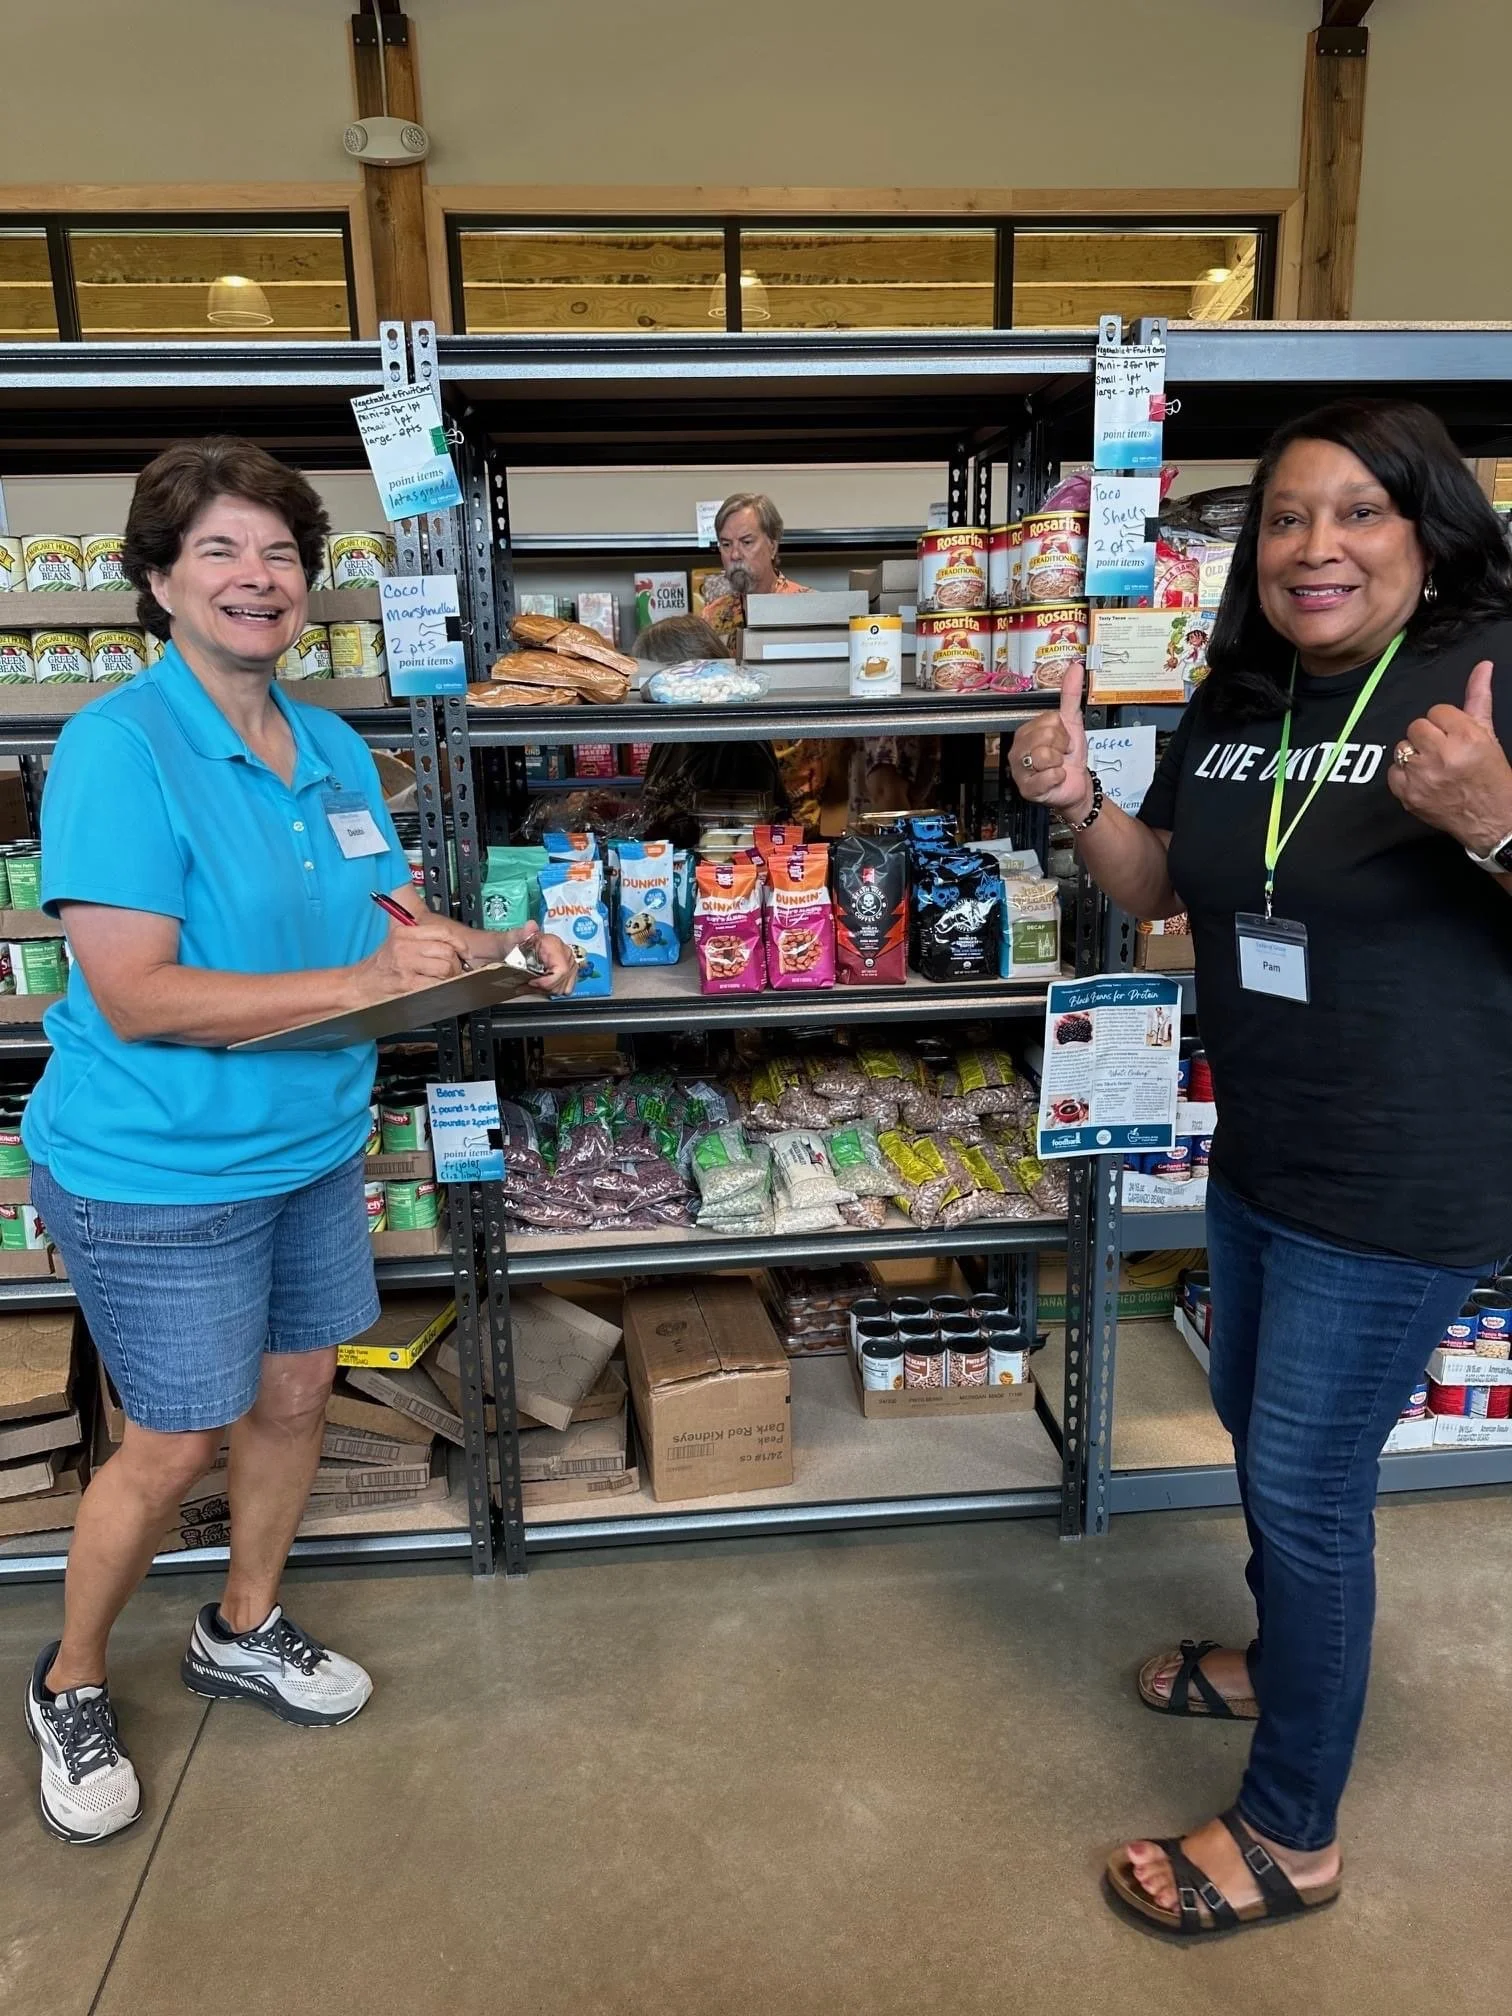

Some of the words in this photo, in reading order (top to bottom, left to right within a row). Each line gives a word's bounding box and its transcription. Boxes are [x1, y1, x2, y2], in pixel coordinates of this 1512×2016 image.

[1103, 429, 1125, 441] point
[1127, 429, 1152, 440] items
[389, 475, 415, 491] point
[416, 468, 444, 482] items
[1093, 483, 1121, 501] Taco
[1102, 506, 1146, 526] Shells
[1029, 517, 1082, 538] Rosarita
[936, 533, 984, 552] Rosarita
[1094, 539, 1105, 552] 2
[345, 560, 374, 569] GREEN
[1031, 554, 1079, 565] TRADITIONAL
[1096, 558, 1119, 568] point
[1120, 557, 1145, 567] items
[38, 563, 70, 572] GREEN
[347, 569, 375, 577] BEANS
[940, 568, 982, 577] TRADITIONAL
[42, 572, 72, 581] BEANS
[657, 588, 684, 600] CORN
[657, 599, 685, 609] FLAKES
[1036, 608, 1088, 629] Rosarita
[933, 615, 980, 635] Rosarita
[391, 637, 402, 654] 2
[410, 639, 436, 656] pts
[1040, 644, 1083, 655] TRADITIONAL
[47, 655, 78, 664] GREEN
[102, 654, 132, 663] GREEN
[935, 649, 978, 659] TRADITIONAL
[0, 656, 26, 665] REEN
[399, 657, 425, 669] point
[427, 657, 455, 667] items
[51, 664, 80, 672] BEANS
[104, 663, 133, 671] BEANS
[1194, 743, 1266, 782] LIVE
[1021, 903, 1053, 913] ROAST
[1263, 961, 1281, 973] Pam
[1128, 988, 1159, 1001] Protein
[436, 1088, 466, 1098] Beans
[439, 1104, 464, 1115] pound
[444, 1151, 467, 1159] point
[1150, 1194, 1166, 1205] BEANS
[727, 1426, 752, 1439] Red
[755, 1422, 785, 1436] Dark
[672, 1430, 724, 1444] Kidneys
[758, 1435, 784, 1447] Peak
